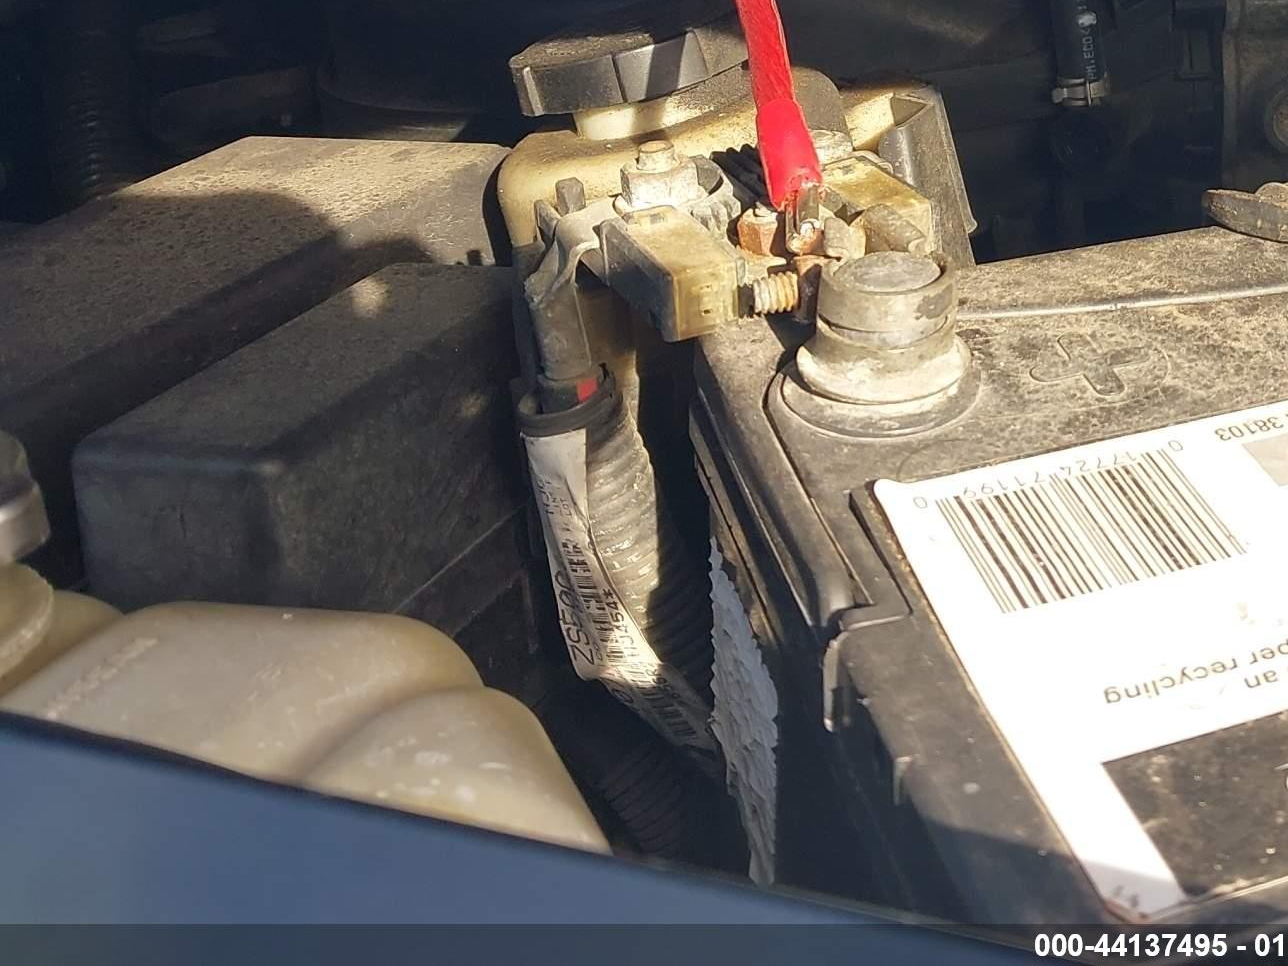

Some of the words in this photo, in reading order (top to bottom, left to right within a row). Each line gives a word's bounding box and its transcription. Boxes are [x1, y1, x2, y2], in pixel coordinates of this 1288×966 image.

[1214, 417, 1284, 442] 38103
[1168, 440, 1184, 452] 0
[913, 497, 929, 509] 0
[1104, 659, 1238, 704] recycling
[1244, 671, 1278, 689] an
